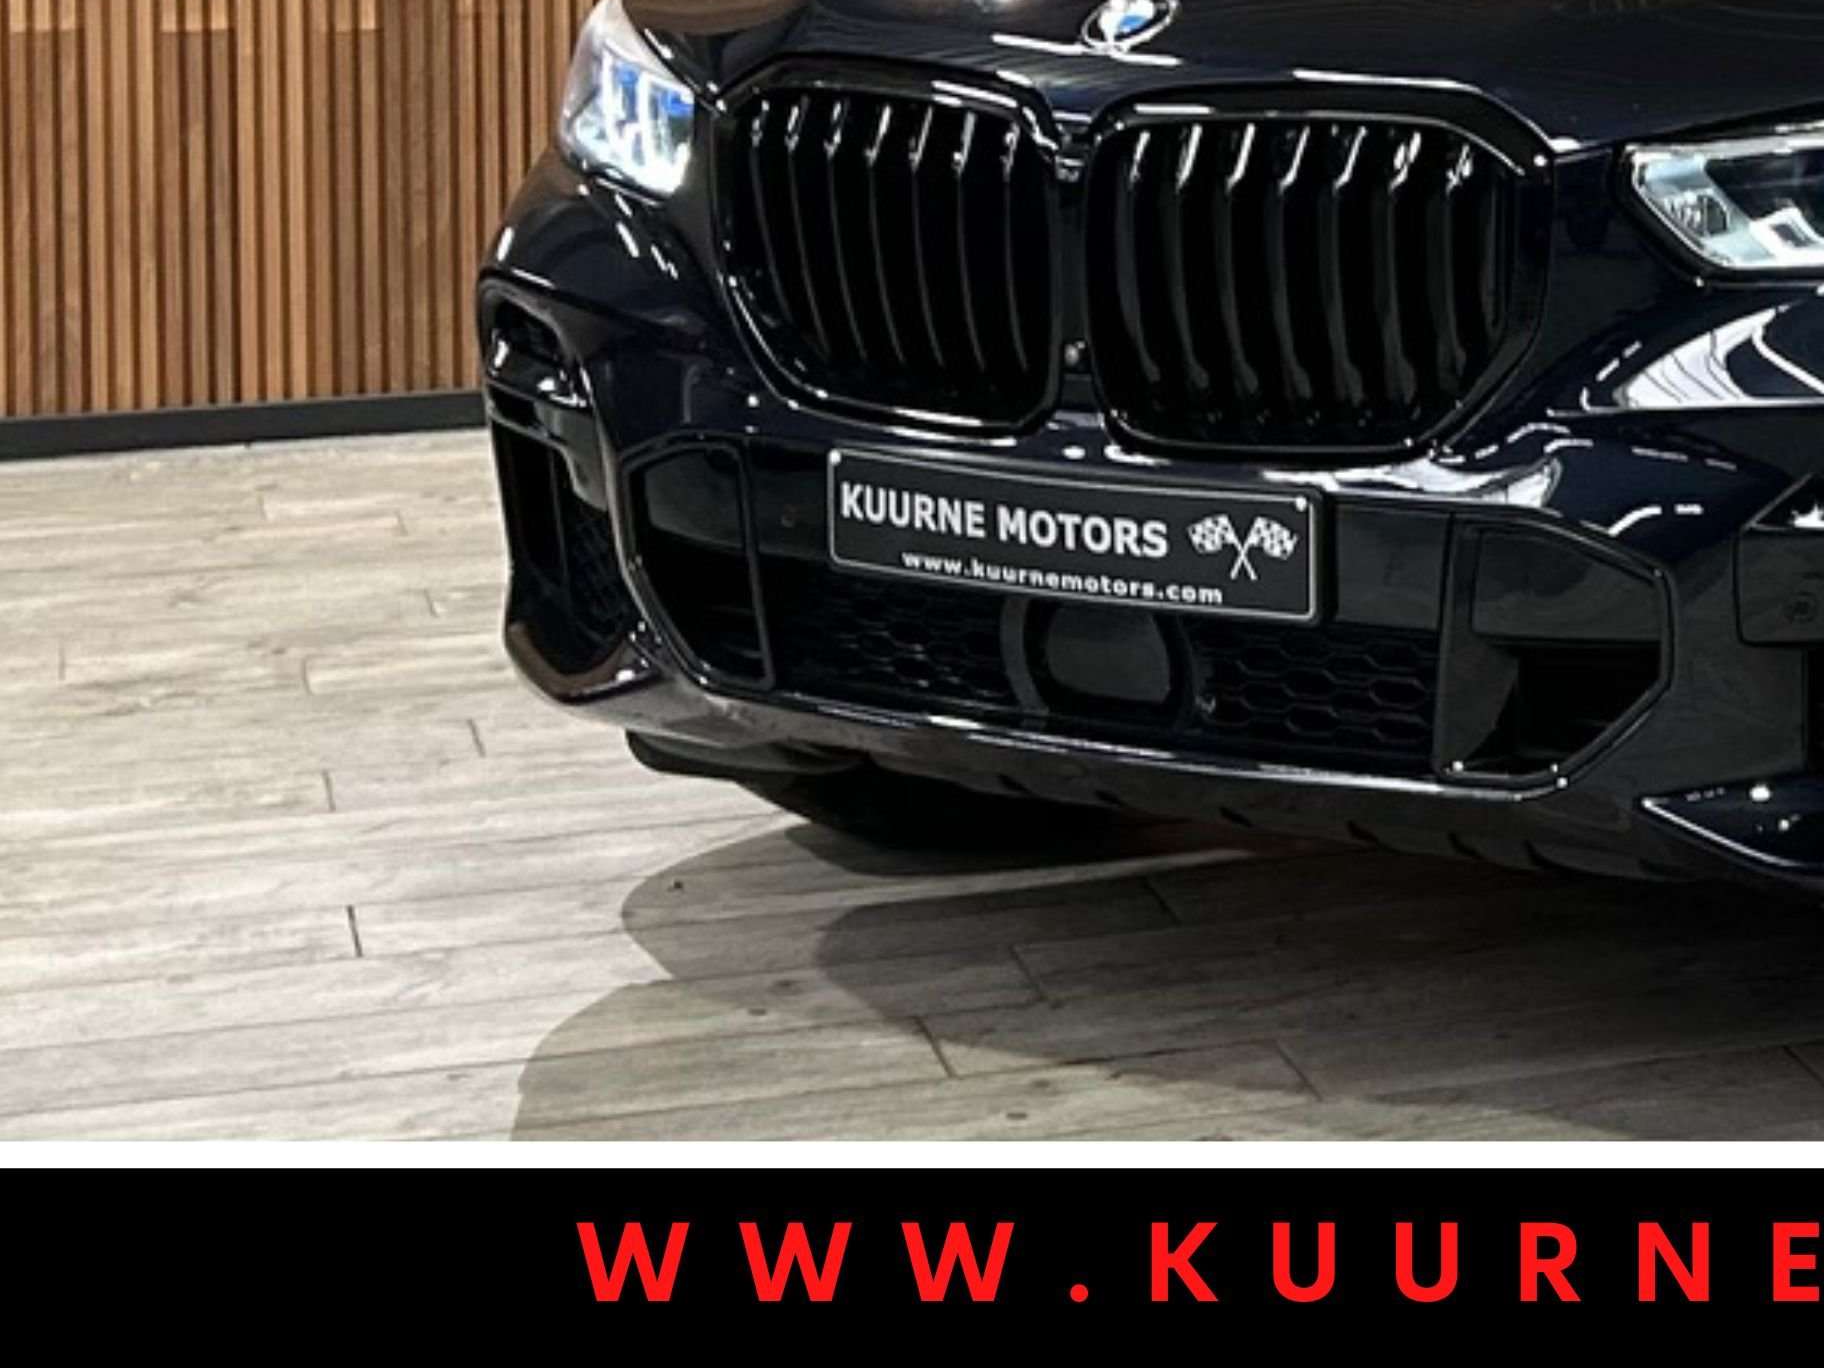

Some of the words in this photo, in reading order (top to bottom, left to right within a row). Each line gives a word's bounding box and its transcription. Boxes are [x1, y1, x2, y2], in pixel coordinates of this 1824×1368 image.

[841, 482, 985, 537] KUURNE
[997, 506, 1168, 558] MOTORS
[902, 552, 1223, 605] www.kuurnemotors.com
